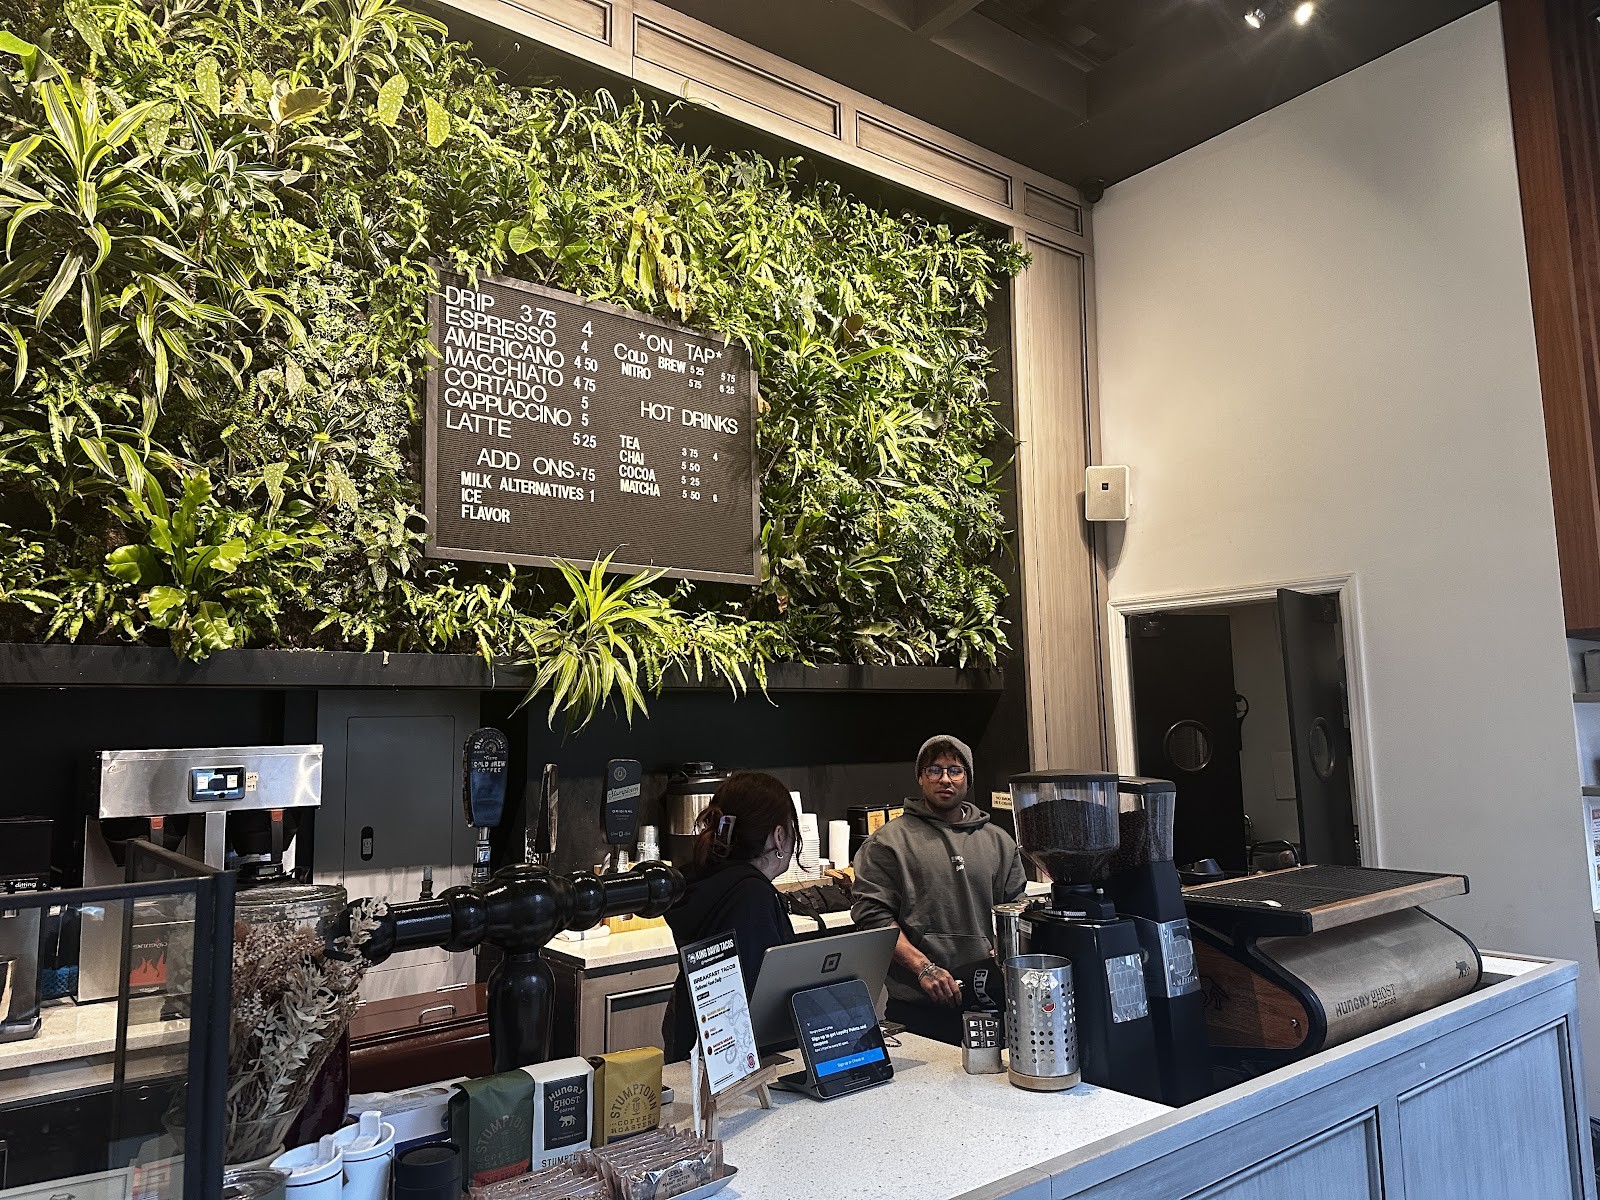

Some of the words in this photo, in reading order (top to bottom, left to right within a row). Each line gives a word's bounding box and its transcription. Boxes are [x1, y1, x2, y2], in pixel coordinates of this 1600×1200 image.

[445, 285, 495, 312] DRIP
[581, 320, 593, 338] 4
[445, 305, 557, 347] ESPRESSO
[581, 340, 589, 354] 4
[444, 326, 565, 369] AMERICANO
[613, 342, 649, 365] COLD
[658, 355, 686, 374] BREW
[445, 346, 564, 387] MACCHIATO
[621, 362, 652, 380] NITRO
[444, 367, 547, 403] CORTADO
[581, 395, 589, 410] 5
[444, 387, 572, 427] CAPPUCCINO
[581, 413, 589, 427] 5
[640, 400, 675, 422] HOT
[681, 409, 739, 435] DRINKS
[446, 409, 512, 439] LATTE
[476, 447, 521, 471] ADD
[533, 456, 575, 479] ONS
[620, 434, 640, 450] TEA
[712, 452, 719, 462] 4
[620, 450, 644, 465] CHAI
[460, 471, 492, 489] MILK
[500, 477, 584, 501] ALTERNATIVES
[589, 489, 595, 503] 1
[619, 464, 656, 482] COCOA
[620, 479, 661, 498] MATCHA
[461, 488, 482, 504] ICE
[461, 504, 511, 523] FLAVOR
[720, 938, 734, 951] TACOS
[693, 969, 720, 985] BREAKFAST
[720, 963, 736, 973] TACOS
[610, 1083, 657, 1119] STUMPTOWN
[617, 1113, 652, 1127] COFFEE
